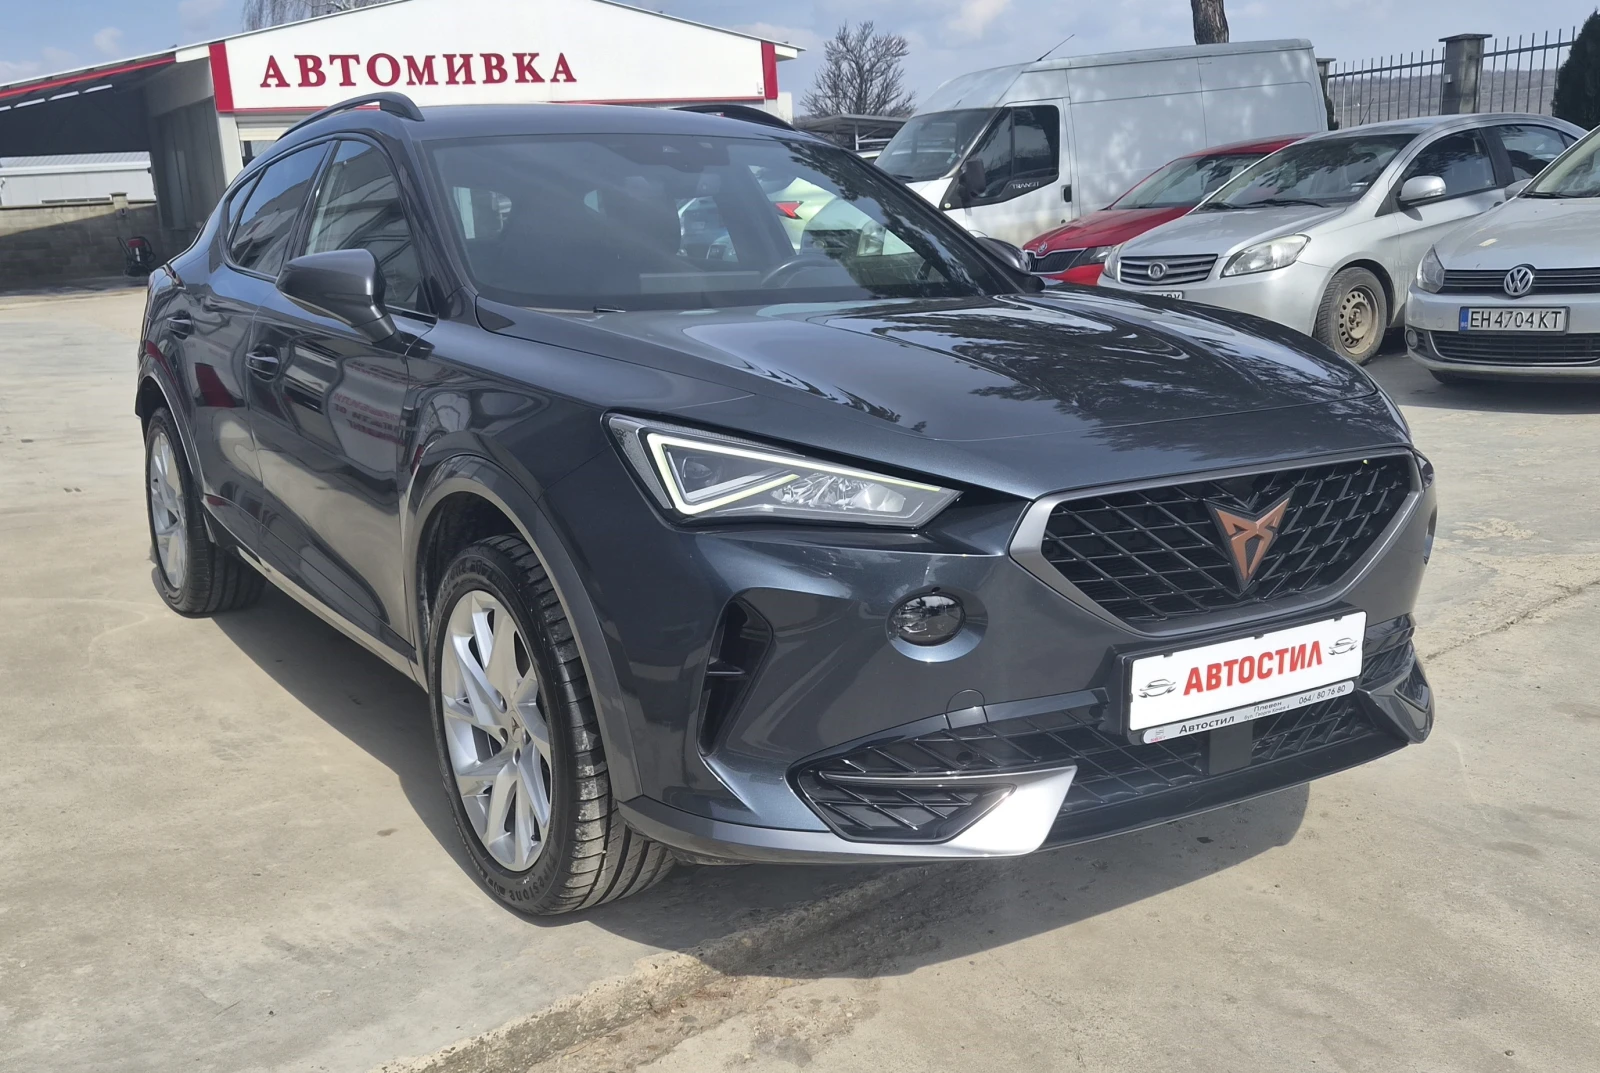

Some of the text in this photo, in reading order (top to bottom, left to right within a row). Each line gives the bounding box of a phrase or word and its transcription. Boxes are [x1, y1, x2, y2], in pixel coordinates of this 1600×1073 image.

[260, 52, 577, 88] АВТОМИВКА
[1183, 640, 1323, 696] АВТОСТИЛ
[1253, 701, 1283, 712] Плевен
[1179, 715, 1236, 735] Автостил
